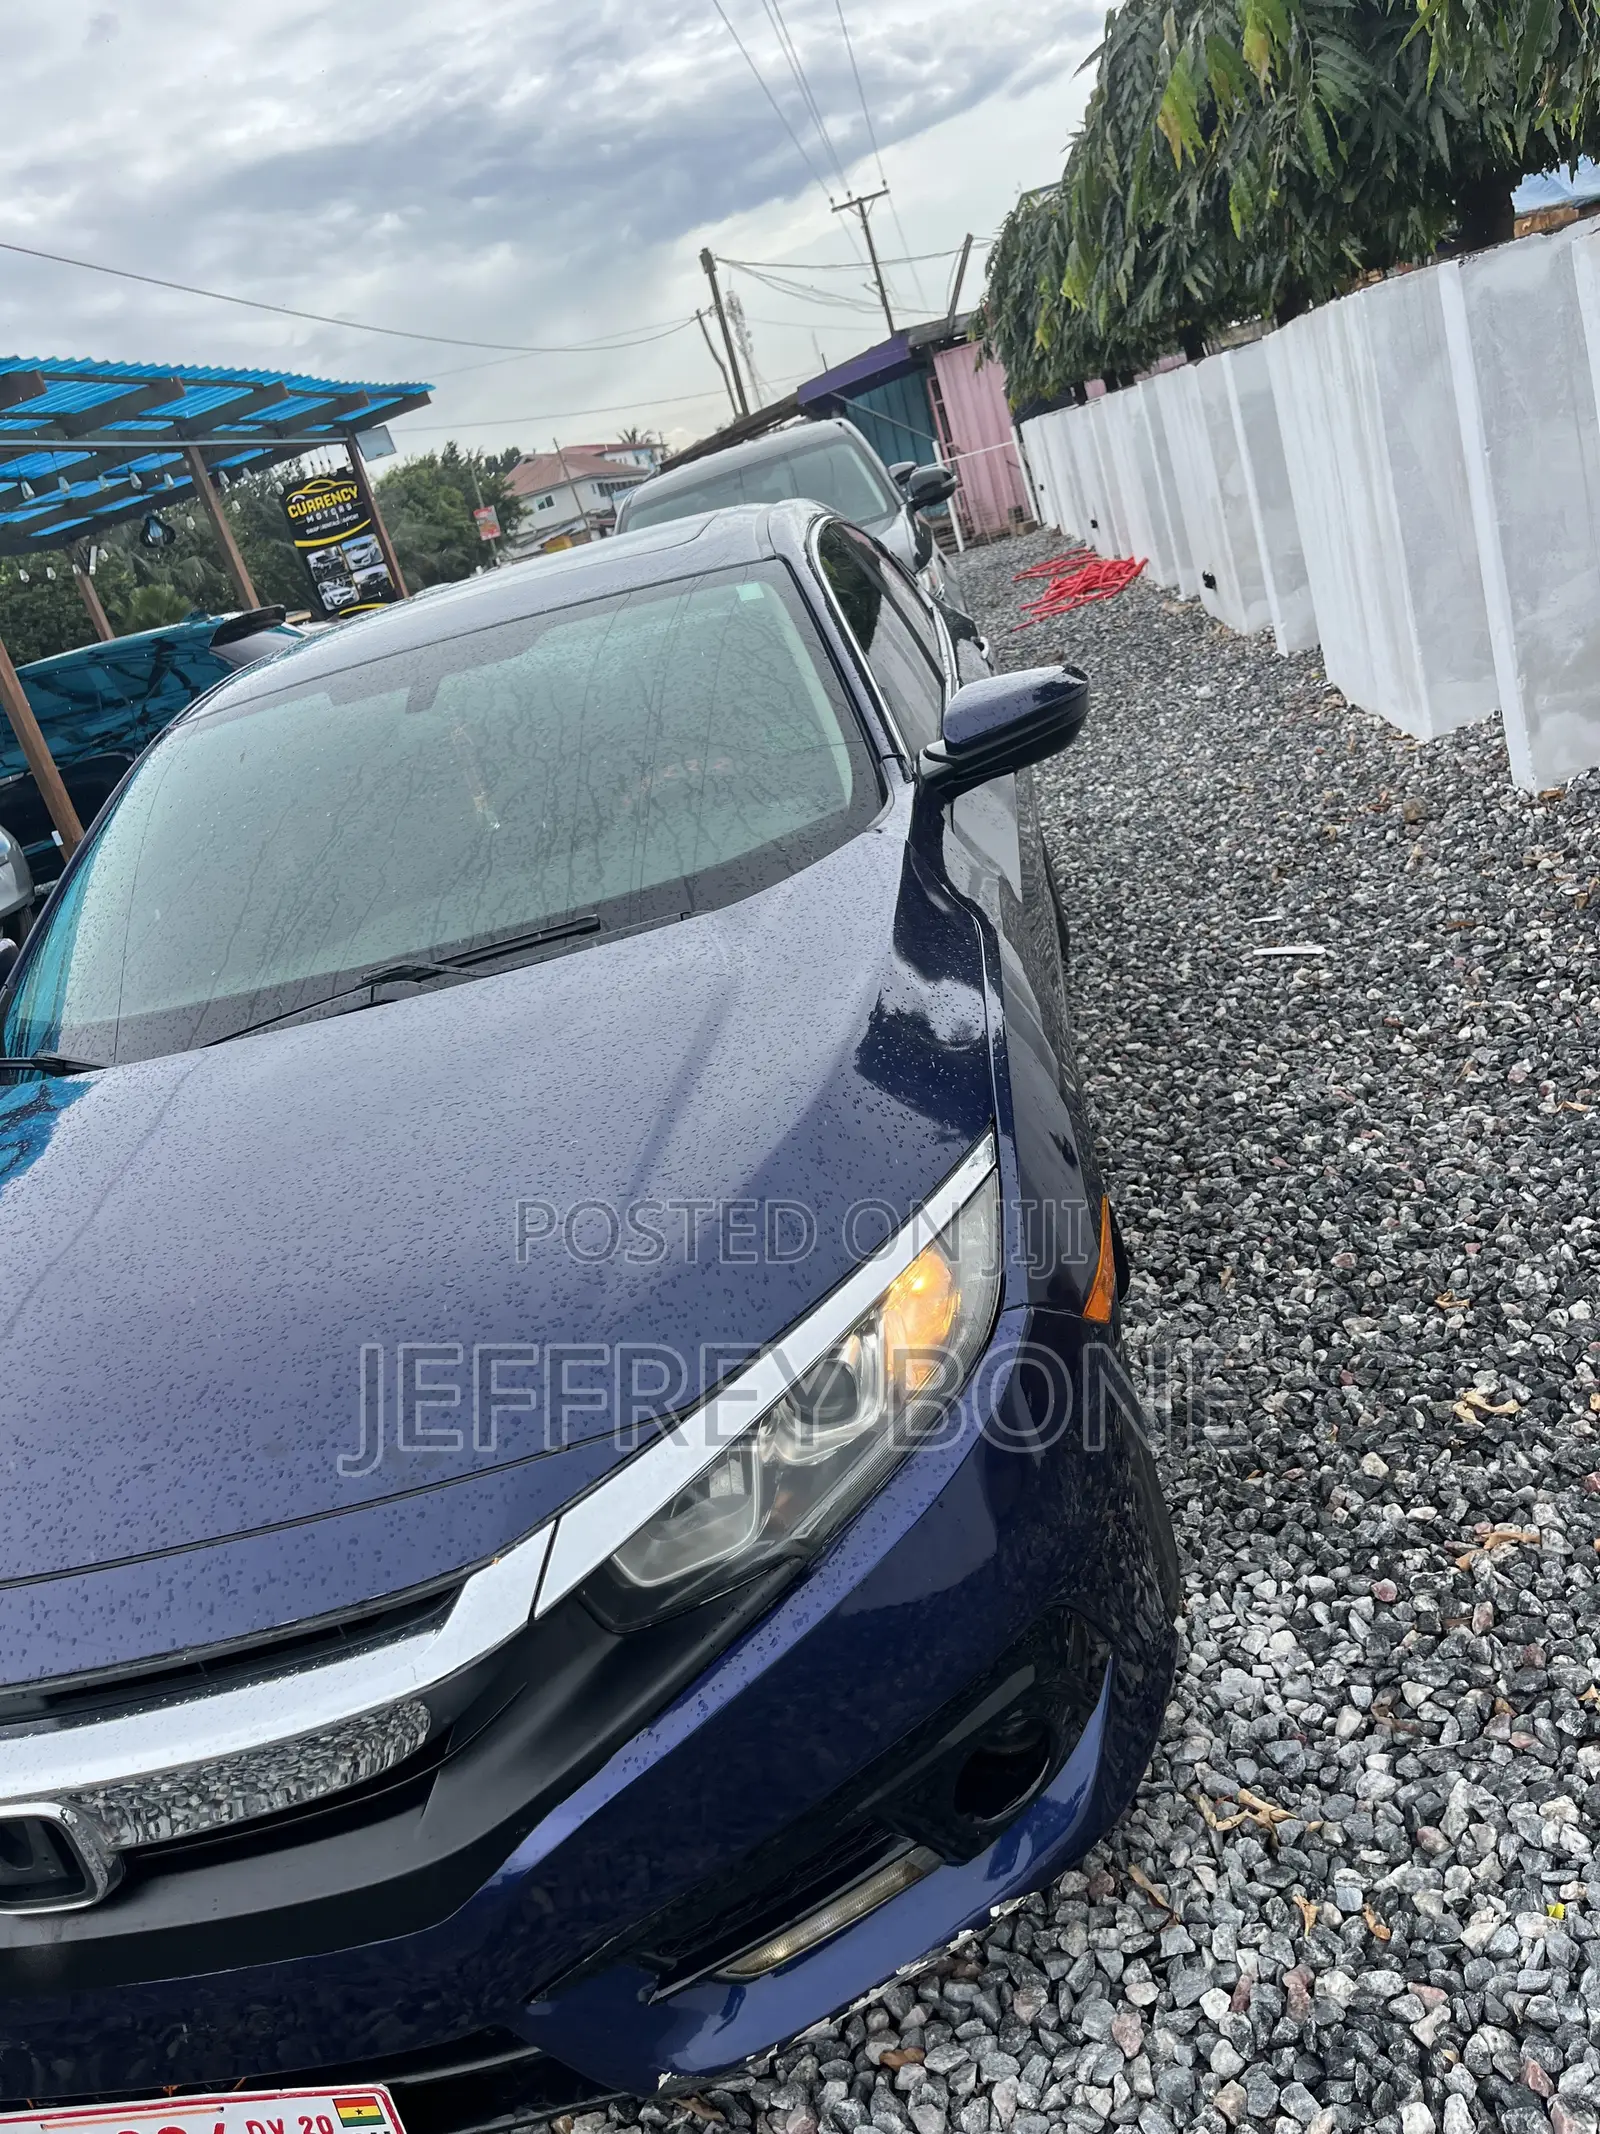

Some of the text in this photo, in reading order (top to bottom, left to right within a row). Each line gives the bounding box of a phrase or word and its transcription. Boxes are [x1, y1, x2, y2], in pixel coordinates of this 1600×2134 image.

[287, 485, 358, 519] CURRENCY
[306, 503, 352, 524] MOTORS
[298, 2115, 334, 2134] 20
